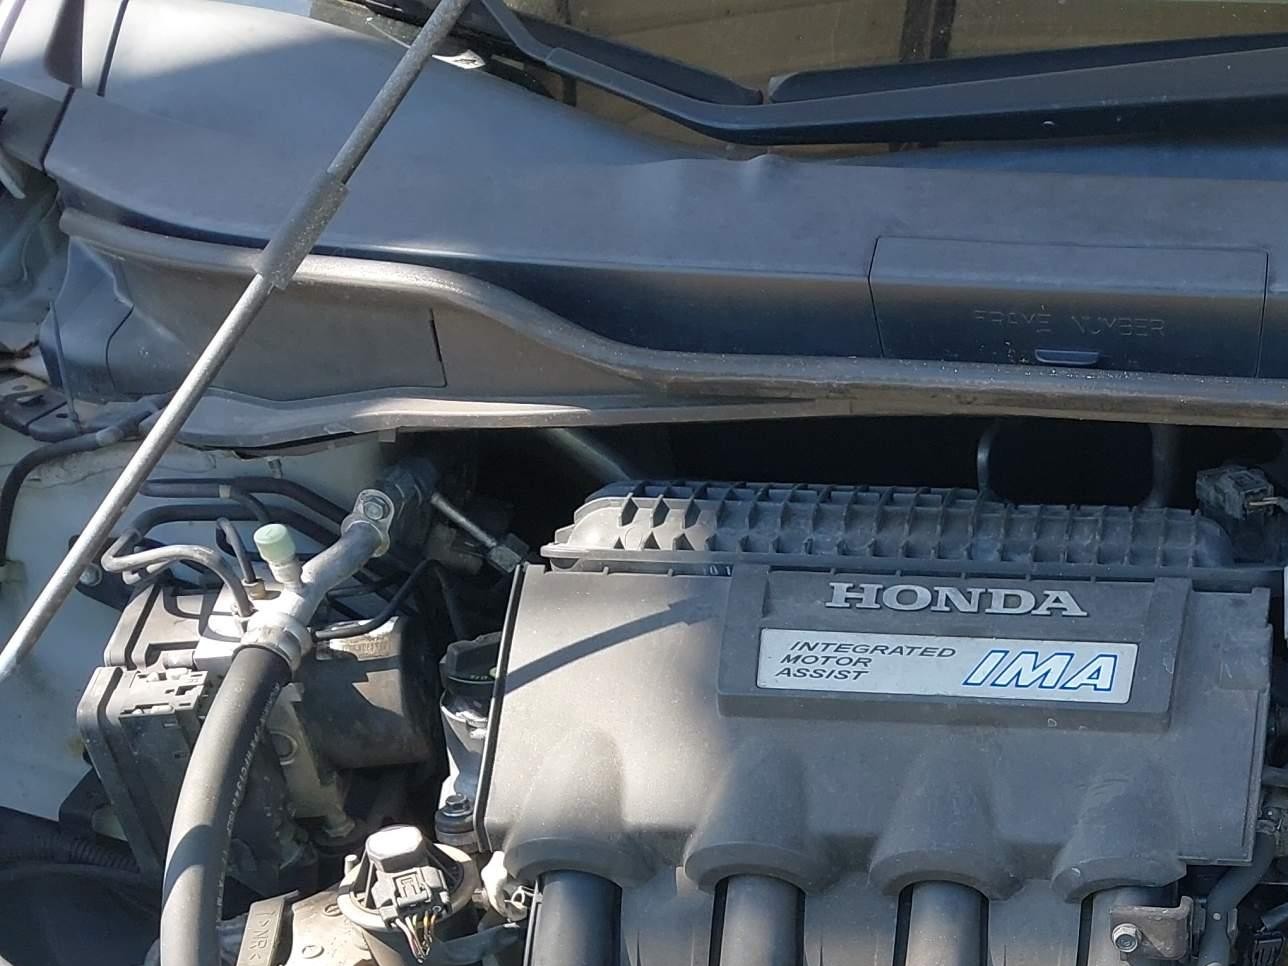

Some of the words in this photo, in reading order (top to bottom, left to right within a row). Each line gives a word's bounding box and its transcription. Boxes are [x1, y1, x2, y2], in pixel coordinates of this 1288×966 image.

[1071, 315, 1166, 337] NUMBER
[825, 581, 1089, 618] HONDA
[789, 640, 957, 659] INTEGRATED
[780, 653, 873, 668] MOTOR
[963, 648, 1119, 693] IMA
[775, 666, 869, 681] ASSIST
